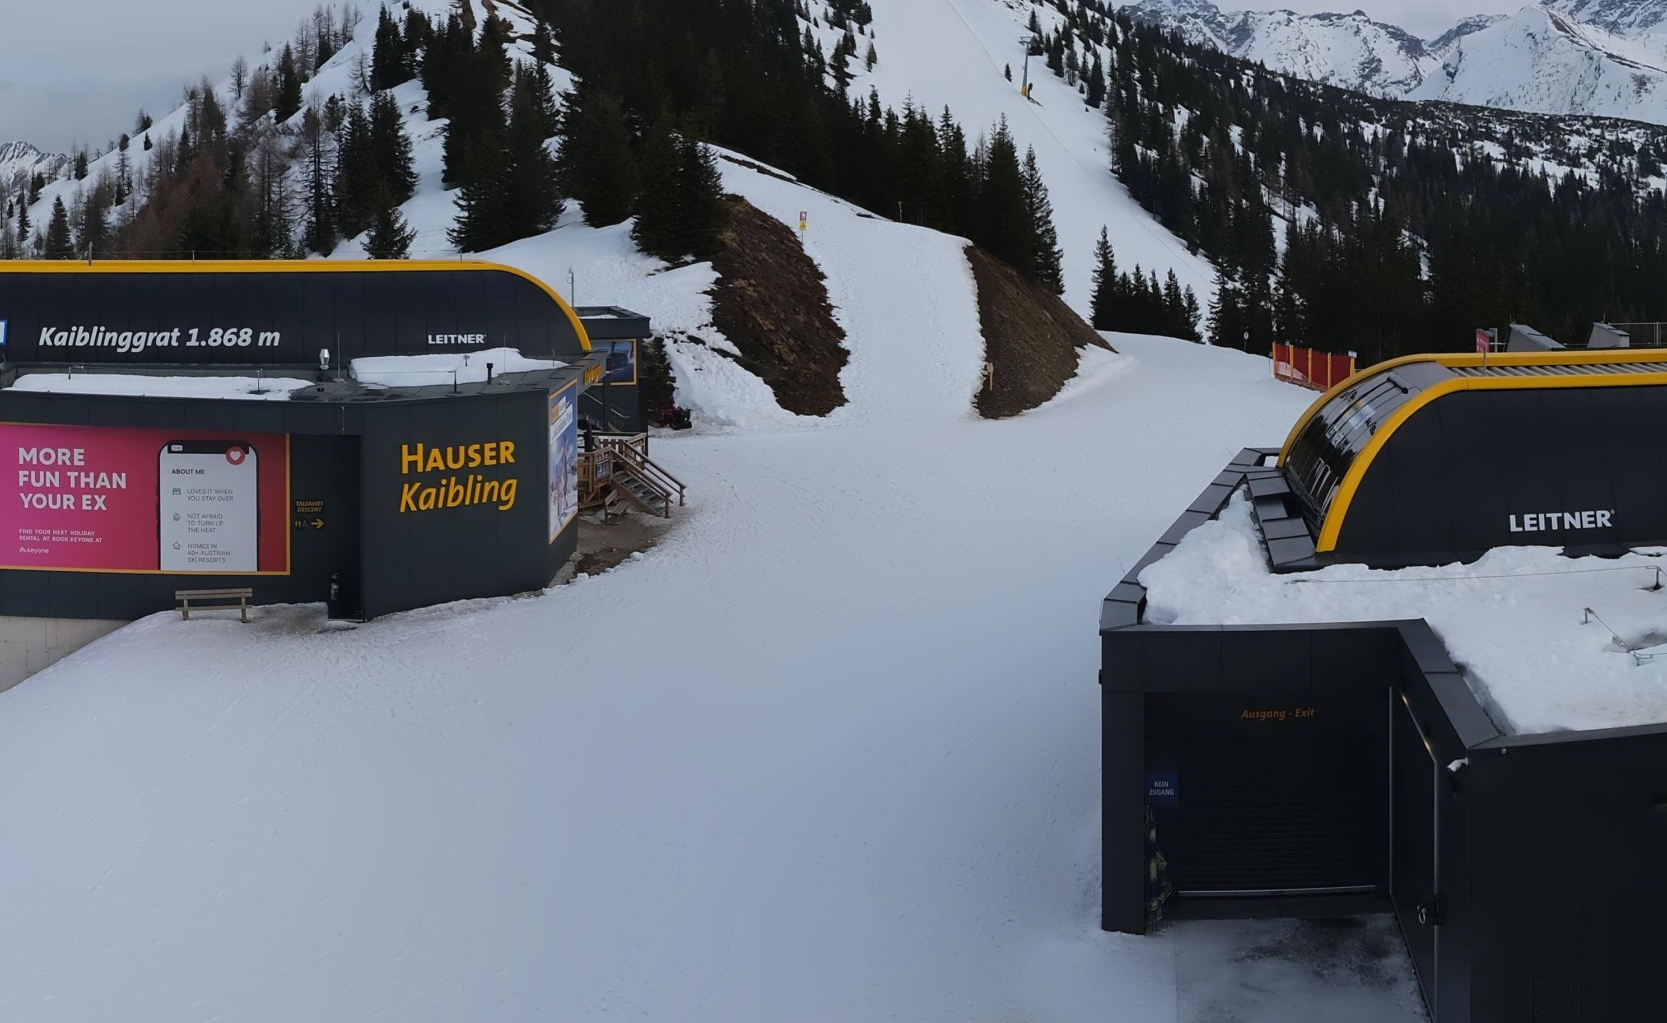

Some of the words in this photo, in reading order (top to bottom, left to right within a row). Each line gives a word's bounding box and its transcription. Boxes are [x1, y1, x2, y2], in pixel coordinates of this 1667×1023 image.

[38, 326, 181, 353] Kaiblinggrat
[186, 327, 253, 347] 1.868
[258, 331, 281, 347] m
[428, 333, 485, 345] LEITNER
[18, 447, 85, 466] MORE
[401, 440, 516, 474] HAUSER
[18, 470, 60, 488] FUN
[67, 471, 127, 489] THAN
[19, 493, 75, 510] YOUR
[82, 494, 107, 511] EX
[400, 474, 518, 513] Kaibling
[1509, 509, 1613, 532] LEITNER
[26, 546, 50, 555] keyone
[1241, 708, 1287, 721] Ausgang
[1295, 707, 1316, 718] Exit
[1149, 788, 1175, 796] ZUGANG
[1154, 780, 1169, 788] KEIN
